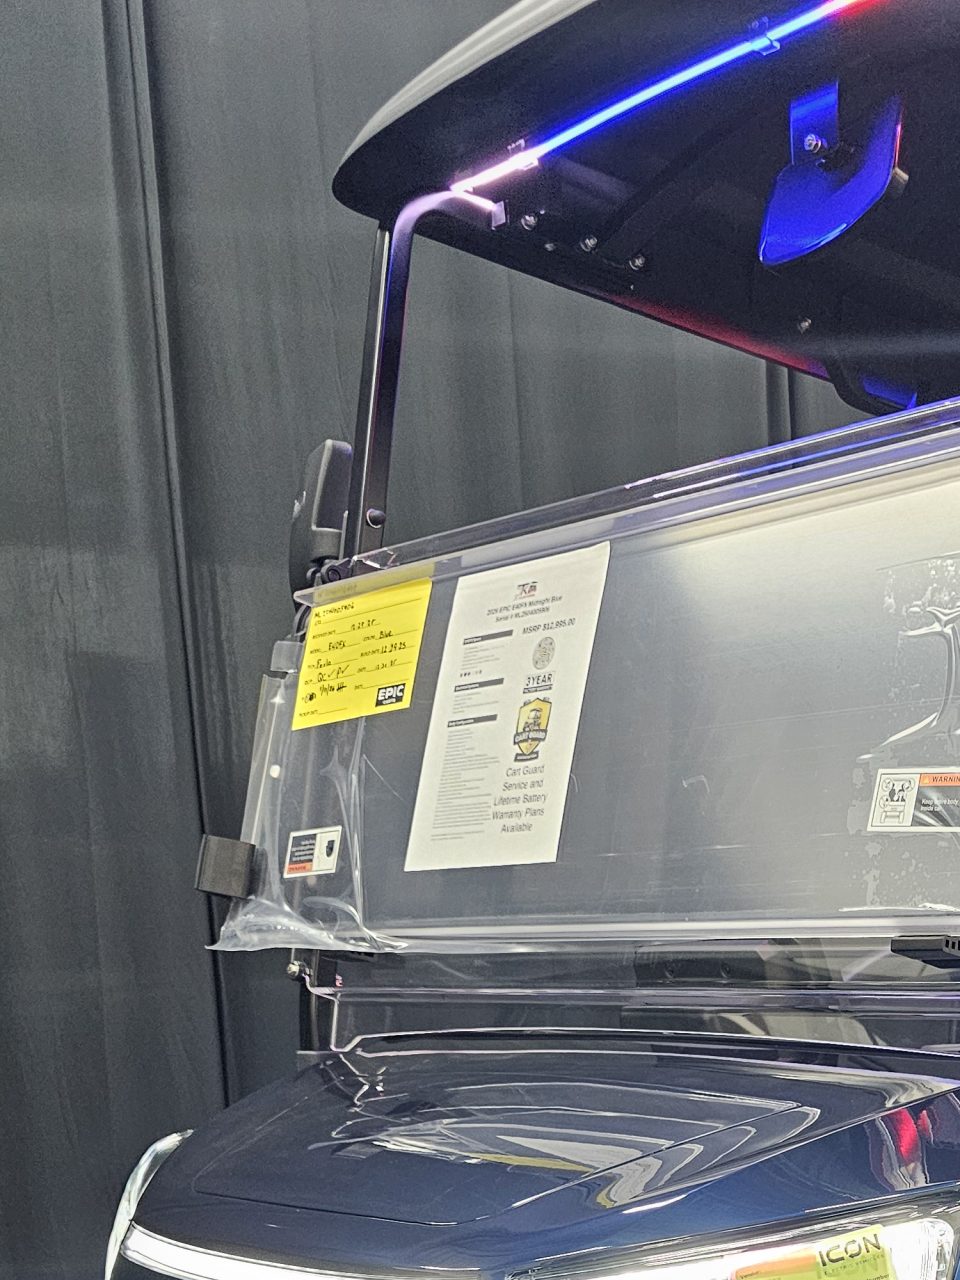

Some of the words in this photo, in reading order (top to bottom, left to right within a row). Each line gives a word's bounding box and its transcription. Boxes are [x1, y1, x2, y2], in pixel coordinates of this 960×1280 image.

[378, 685, 404, 700] EPIC
[506, 768, 521, 777] Cart
[523, 765, 544, 775] Guard
[502, 782, 528, 791] Service
[530, 779, 544, 788] and
[494, 796, 520, 806] Lifetime
[522, 794, 546, 804] Battery
[492, 810, 522, 820] Warranty
[525, 807, 544, 816] Plans
[501, 823, 533, 832] Available
[818, 1233, 881, 1267] ICON
